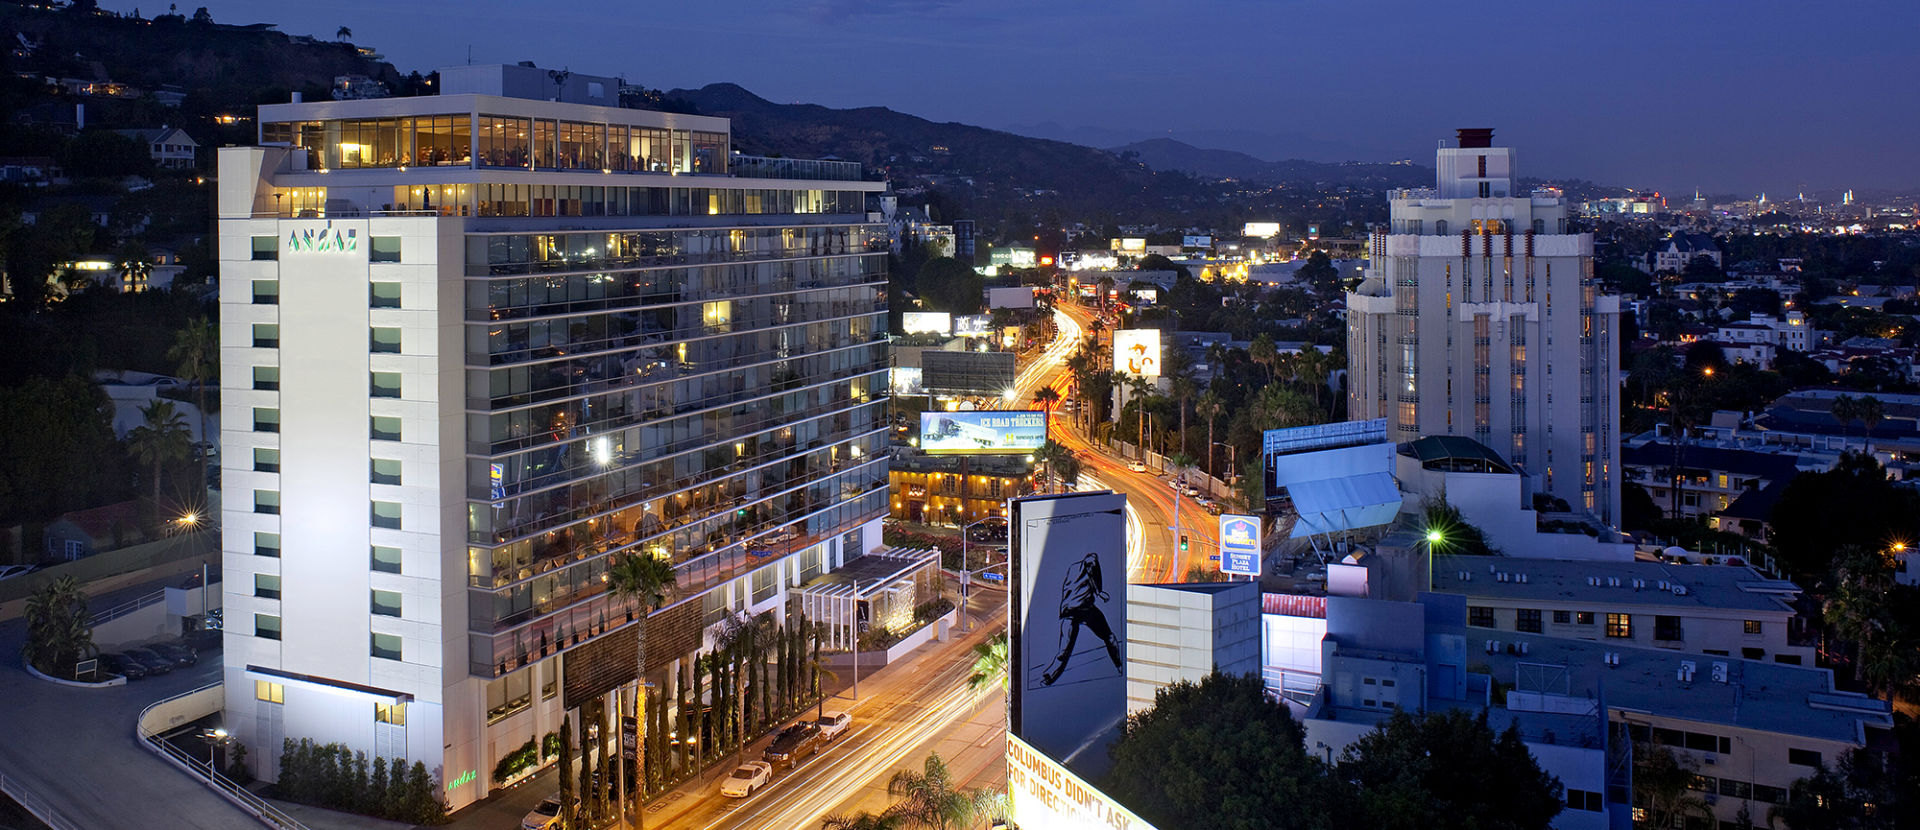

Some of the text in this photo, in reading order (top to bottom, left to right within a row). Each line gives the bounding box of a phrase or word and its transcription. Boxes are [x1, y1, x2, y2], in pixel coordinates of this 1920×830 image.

[981, 418, 991, 427] ICE
[1007, 739, 1132, 830] COLUMBUS DIDN'T ASK
[1008, 761, 1026, 789] FOR
